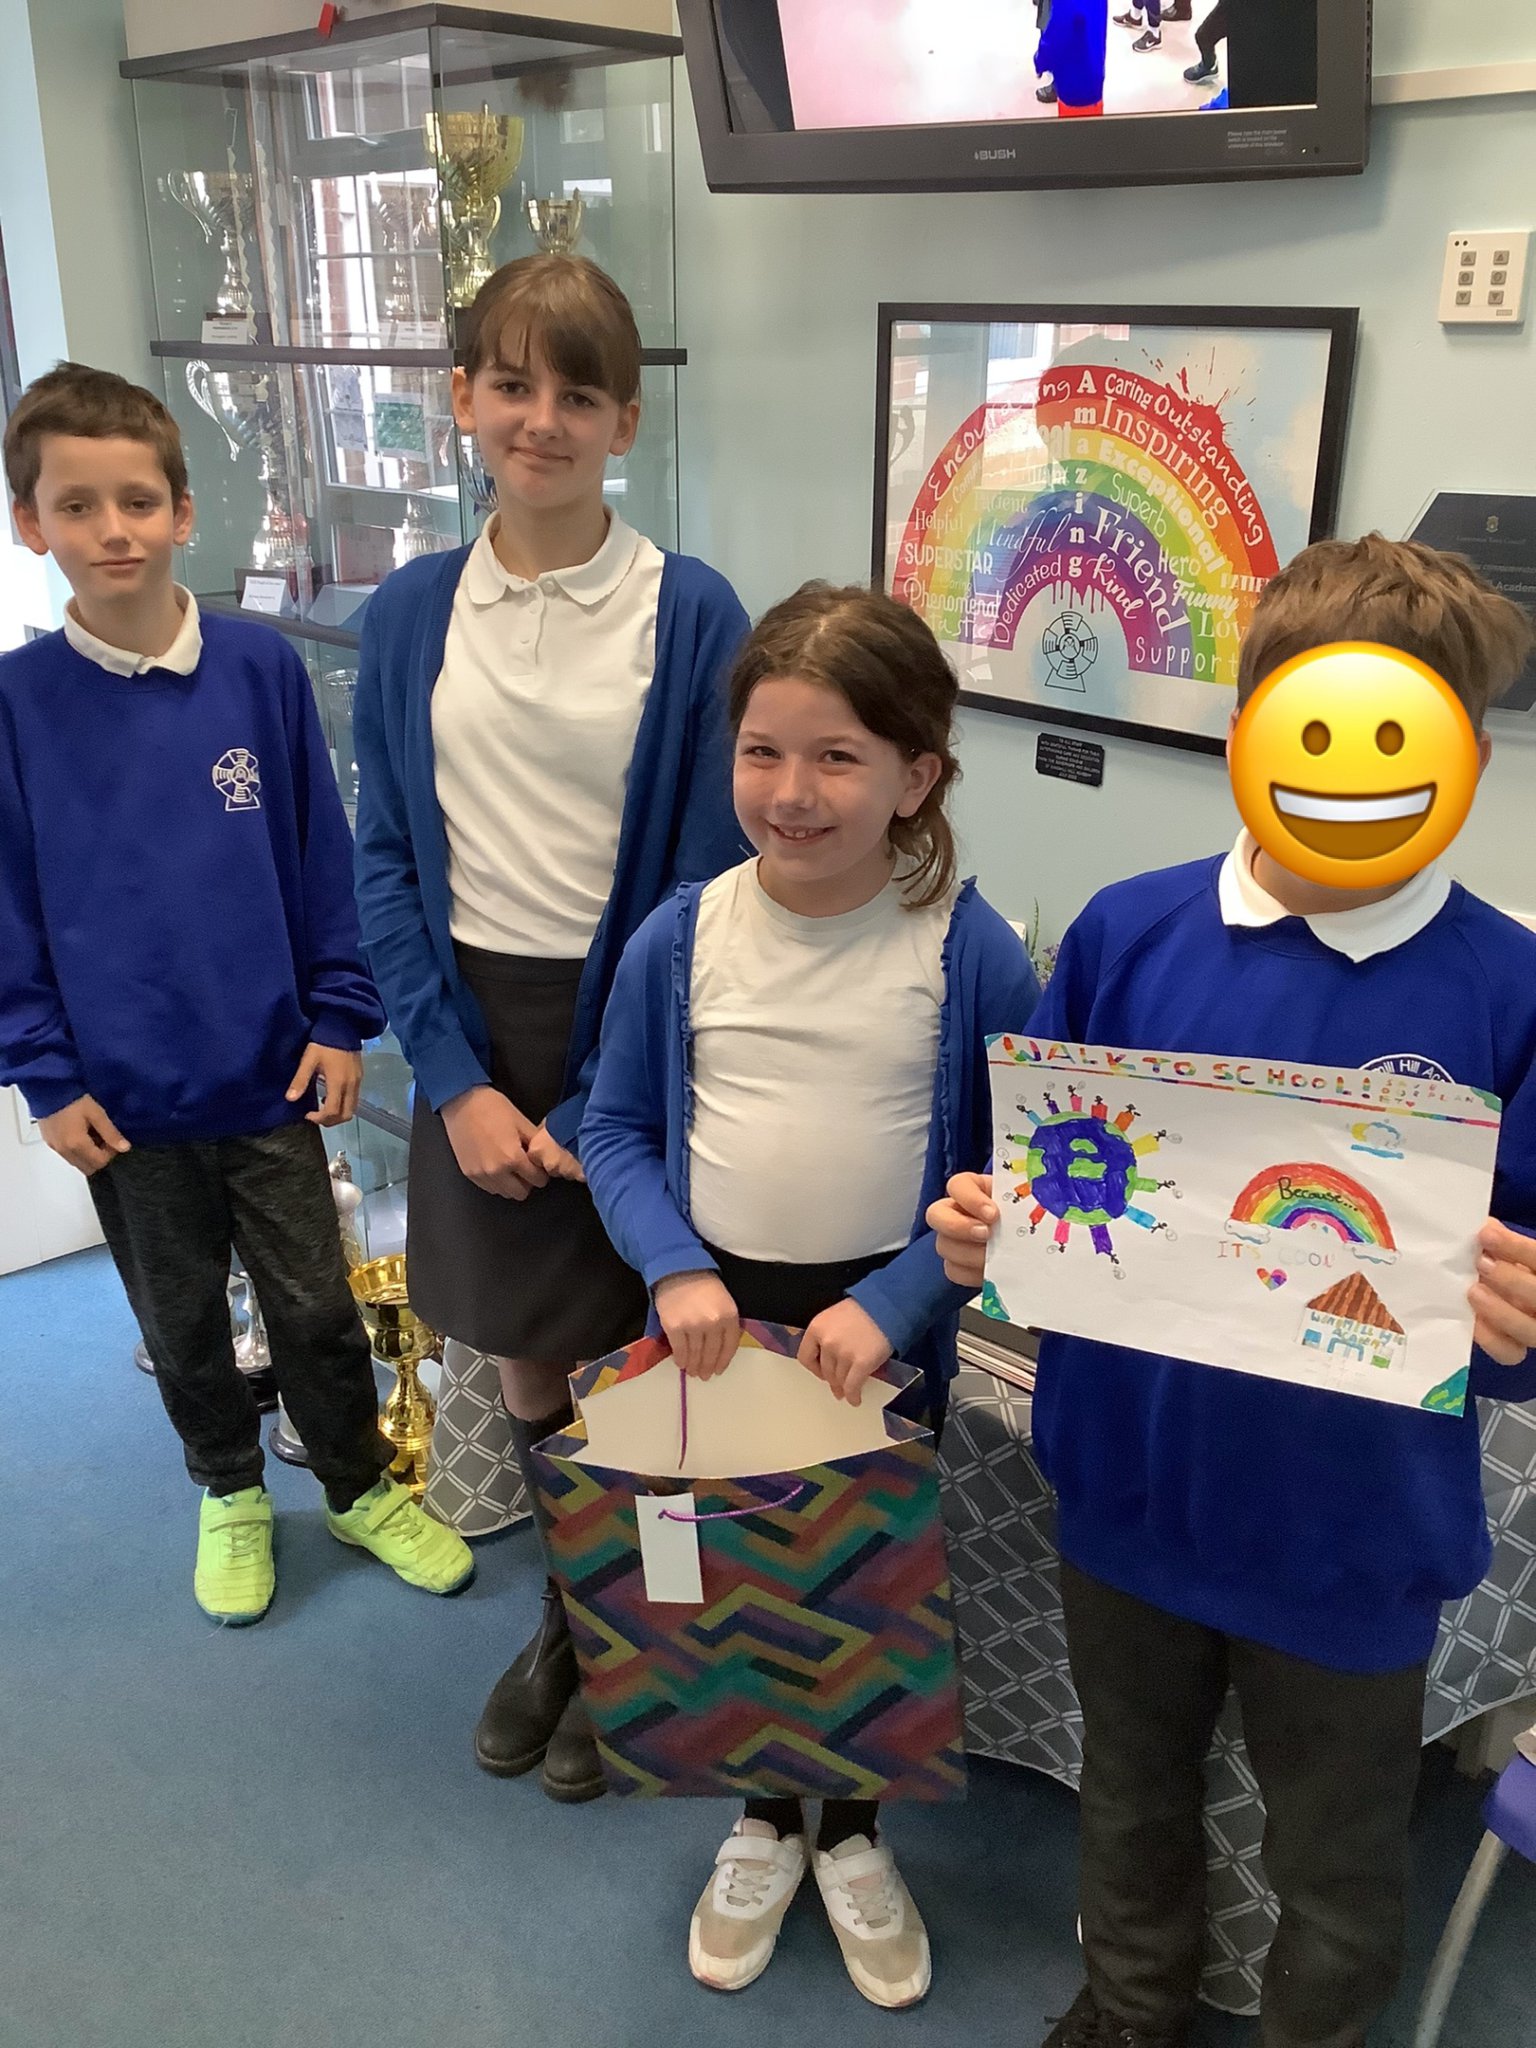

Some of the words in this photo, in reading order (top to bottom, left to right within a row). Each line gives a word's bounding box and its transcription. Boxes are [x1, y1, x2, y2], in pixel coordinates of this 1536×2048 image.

[980, 149, 1016, 160] BUSH
[1098, 394, 1232, 530] Inspiring
[1105, 373, 1153, 410] Caring
[1154, 394, 1265, 546] Outstanding
[914, 506, 964, 539] Helpful
[1099, 438, 1227, 573] Exceptional
[1110, 472, 1167, 538] Superb
[904, 542, 993, 576] SUPERSTAR
[1089, 506, 1190, 637] Friend
[1158, 544, 1201, 578] Hero
[903, 577, 1000, 619] Phenomenal
[993, 554, 1062, 643] Dedicated
[1086, 553, 1144, 620] Kind
[1171, 578, 1240, 619] Funny
[1496, 580, 1536, 593] Academ
[931, 614, 996, 639] tastic
[1199, 610, 1250, 642] Lov
[1003, 1036, 1136, 1071] WALK
[1142, 1056, 1196, 1077] TO
[1213, 1062, 1371, 1099] SCHOOL!
[1400, 1060, 1420, 1073] Hill
[1422, 1066, 1446, 1083] Ac
